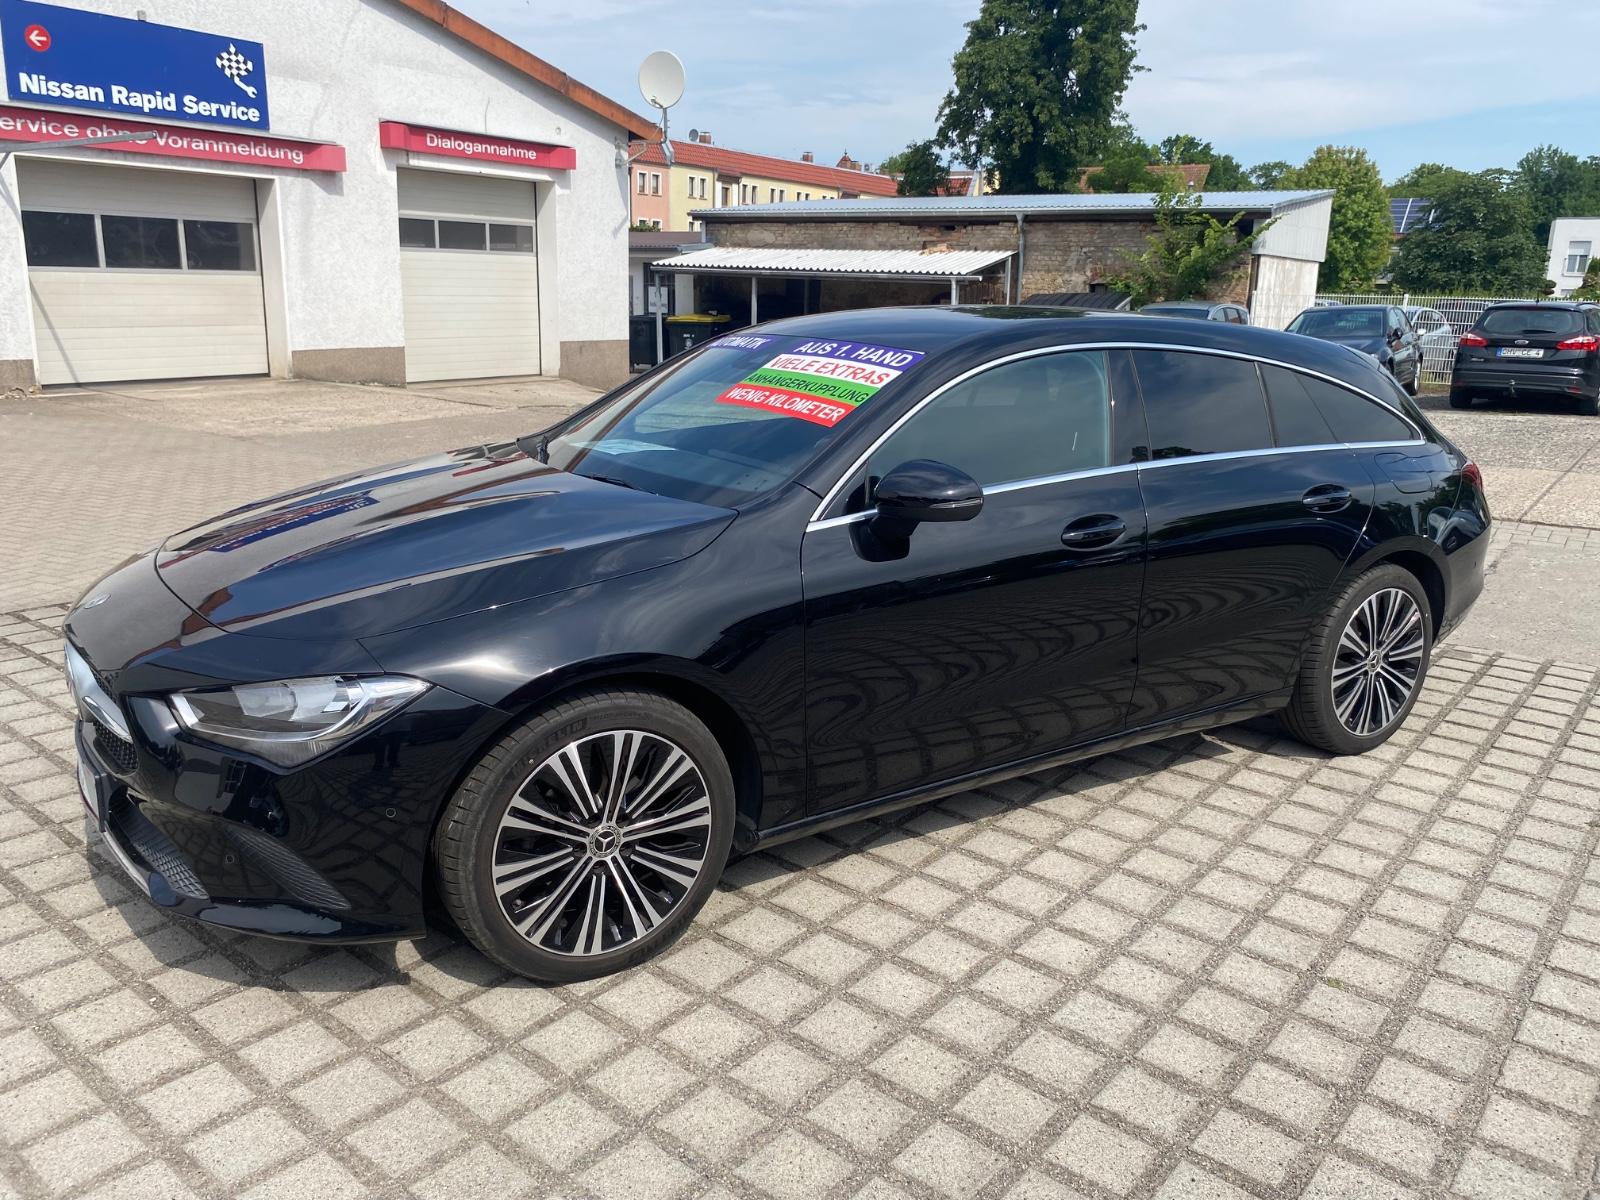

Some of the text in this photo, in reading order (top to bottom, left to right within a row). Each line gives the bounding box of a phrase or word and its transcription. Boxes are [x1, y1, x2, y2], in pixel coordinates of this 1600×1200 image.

[19, 72, 260, 122] Nissan Rapid Service
[156, 131, 304, 164] Voranmeldung
[426, 134, 537, 159] Dialogannahme
[793, 342, 913, 367] AUS 1. HAND
[770, 357, 890, 384] VIELE EXTRAS
[727, 388, 845, 420] WENIG KILOMETER
